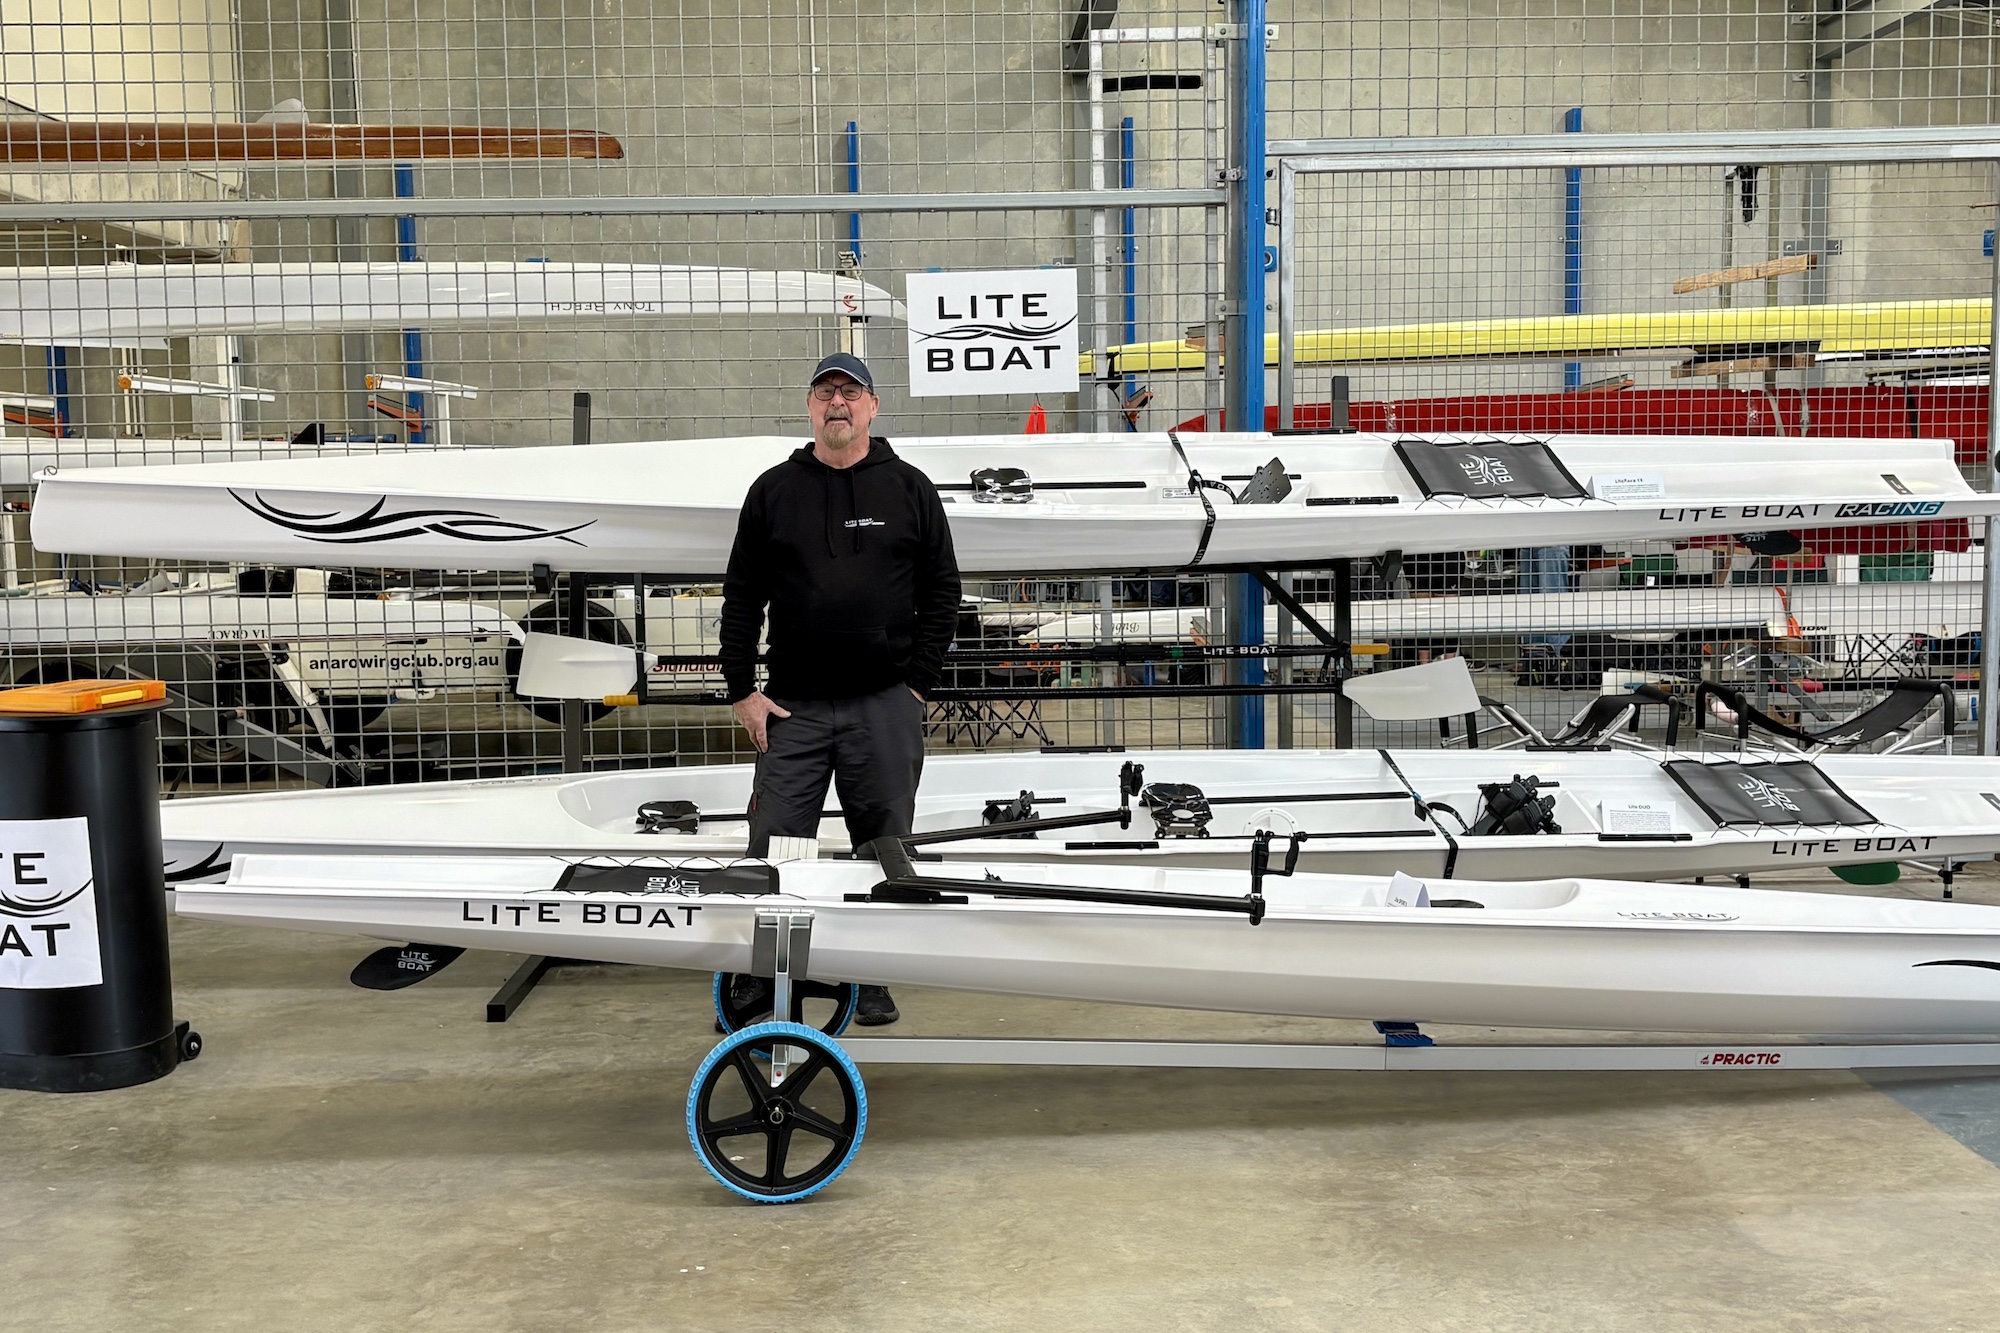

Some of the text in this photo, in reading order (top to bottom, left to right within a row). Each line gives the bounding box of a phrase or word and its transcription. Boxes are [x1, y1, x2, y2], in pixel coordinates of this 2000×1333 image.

[937, 293, 1048, 320] LITE
[927, 345, 1061, 372] BOAT
[1460, 461, 1489, 485] LITE
[1483, 456, 1514, 483] BOAT
[1658, 501, 1942, 522] LITE BOAT RACING
[1203, 645, 1278, 656] LITE BOAT
[309, 654, 500, 671] anarowingclub.org.au
[1738, 781, 1777, 808] LITE
[1772, 836, 1938, 856] LITE BOAT
[0, 853, 48, 884] E
[463, 901, 702, 928] LITE BOAT
[400, 950, 429, 960] LITE
[398, 961, 432, 972] BOAT
[1712, 1053, 1782, 1065] PRACTIC
